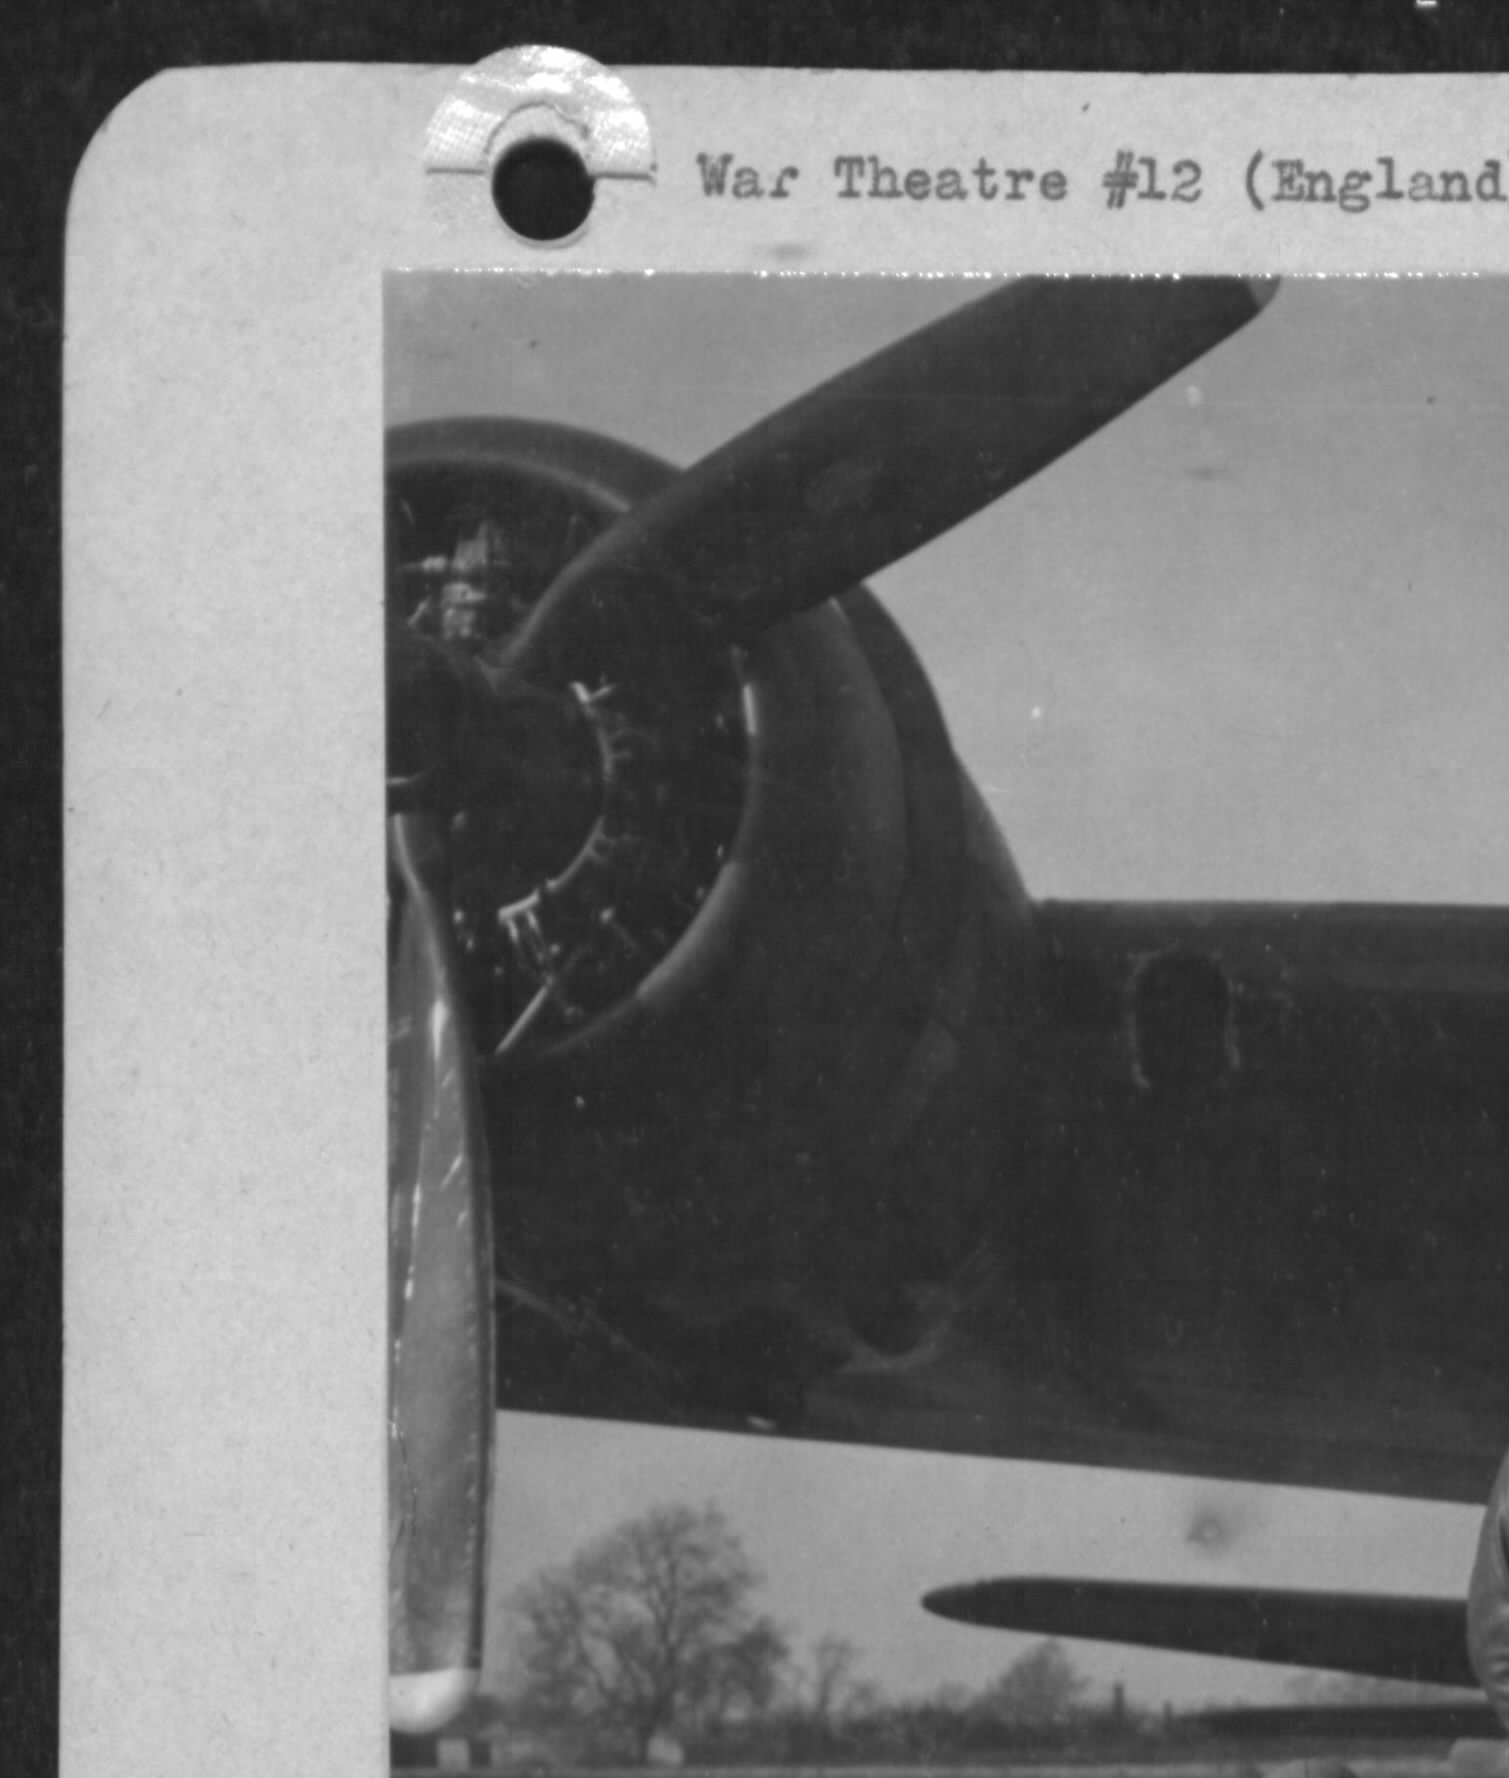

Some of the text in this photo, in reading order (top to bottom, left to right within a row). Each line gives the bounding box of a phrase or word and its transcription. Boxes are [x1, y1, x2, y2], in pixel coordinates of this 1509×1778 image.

[695, 152, 800, 200] War
[833, 154, 1068, 202] Theatre
[1101, 149, 1202, 209] #12
